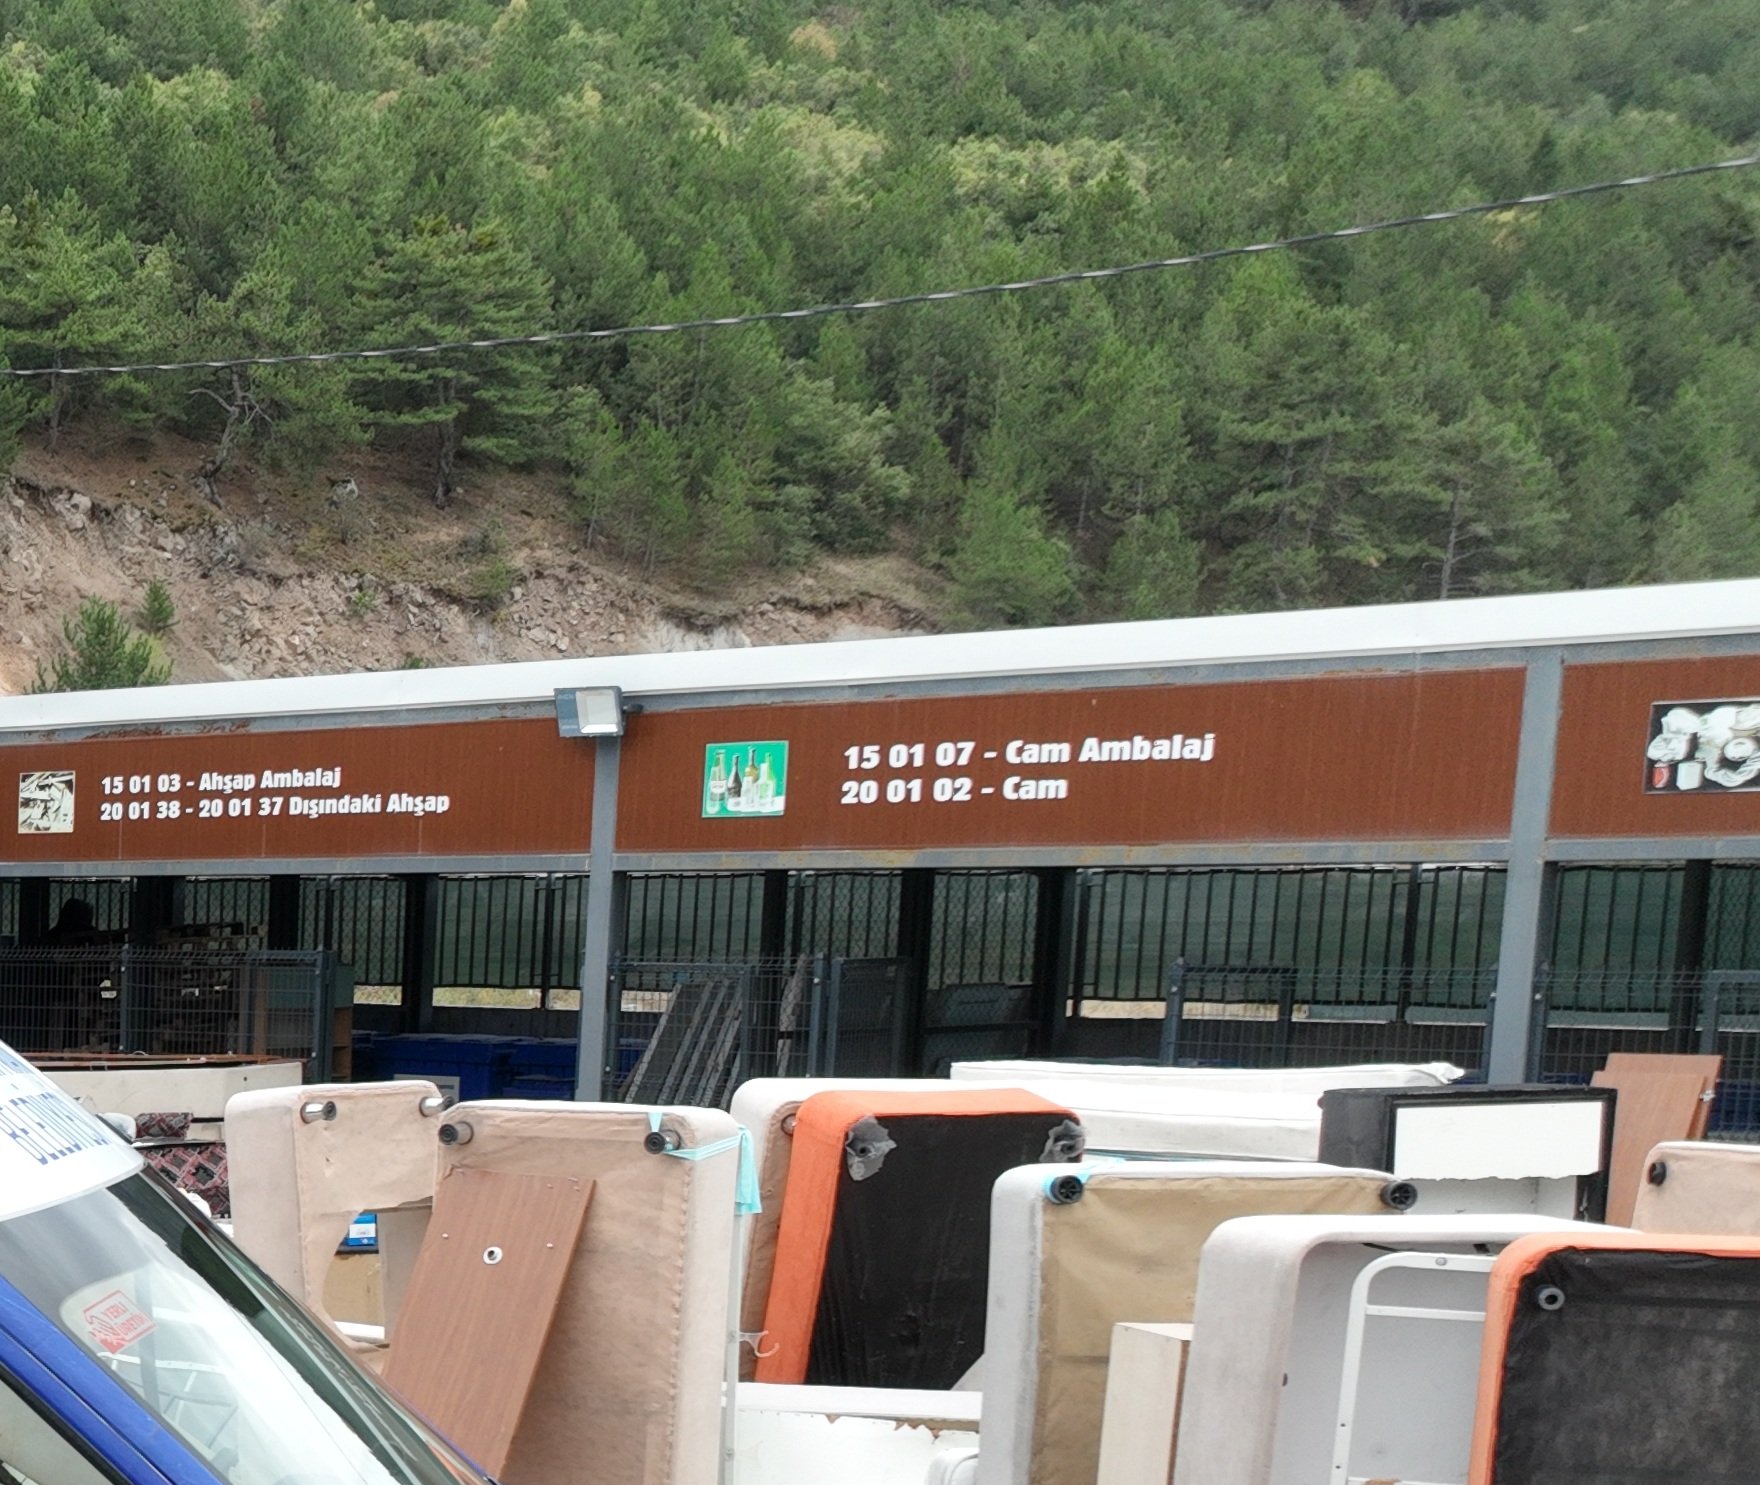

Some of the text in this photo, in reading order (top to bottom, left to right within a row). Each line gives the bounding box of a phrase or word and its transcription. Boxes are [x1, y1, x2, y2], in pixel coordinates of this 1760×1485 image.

[844, 745, 880, 769] 15
[888, 743, 924, 767] 01
[935, 741, 975, 766] 07
[1005, 740, 1070, 763] Cam
[1078, 733, 1215, 762] Ambalaj
[101, 776, 123, 794] 15
[129, 774, 150, 793] 01
[157, 773, 180, 792] 03
[198, 772, 255, 793] Ahşap
[260, 767, 341, 788] Ambalaj
[841, 780, 878, 804] 20
[886, 778, 922, 802] 01
[933, 777, 972, 801] 02
[1003, 776, 1068, 799] Cam
[100, 802, 123, 820] 20
[128, 801, 149, 819] 01
[156, 800, 180, 818] 38
[198, 798, 223, 817] 20
[228, 798, 251, 816] 01
[258, 796, 283, 815] 37
[289, 793, 381, 818] Dışındaki
[386, 793, 449, 815] Ahşap
